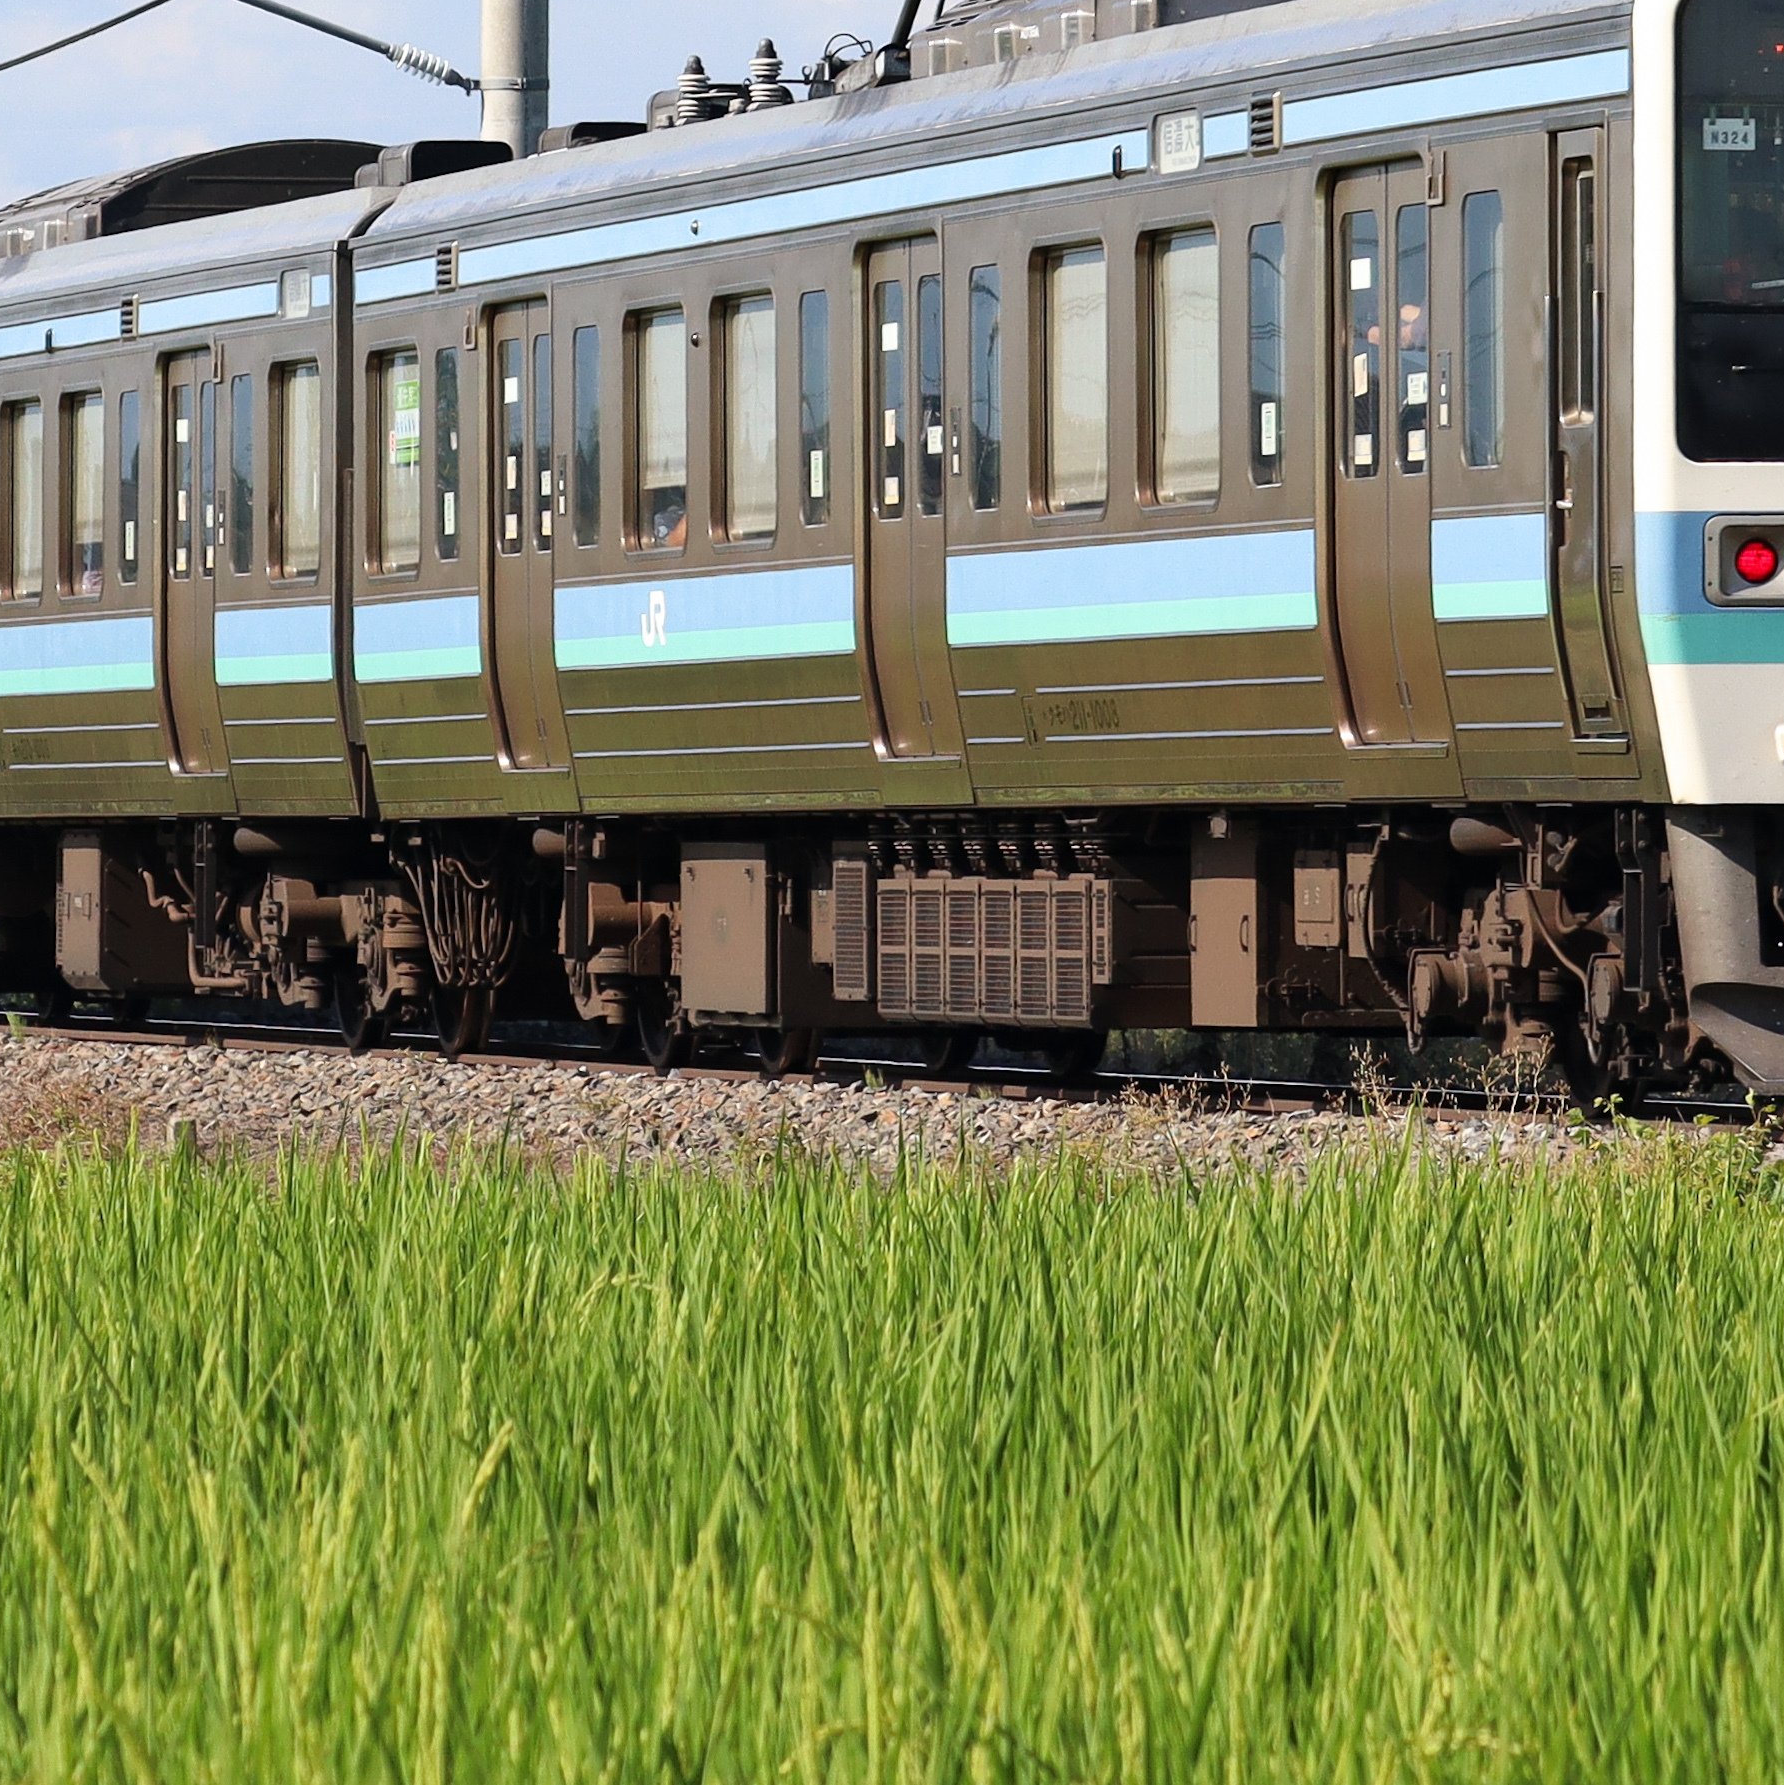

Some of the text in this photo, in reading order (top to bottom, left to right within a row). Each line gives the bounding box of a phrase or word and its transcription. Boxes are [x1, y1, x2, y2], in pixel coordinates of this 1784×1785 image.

[1163, 116, 1200, 154] 信濃大
[1711, 130, 1748, 144] N324
[640, 590, 667, 647] JR
